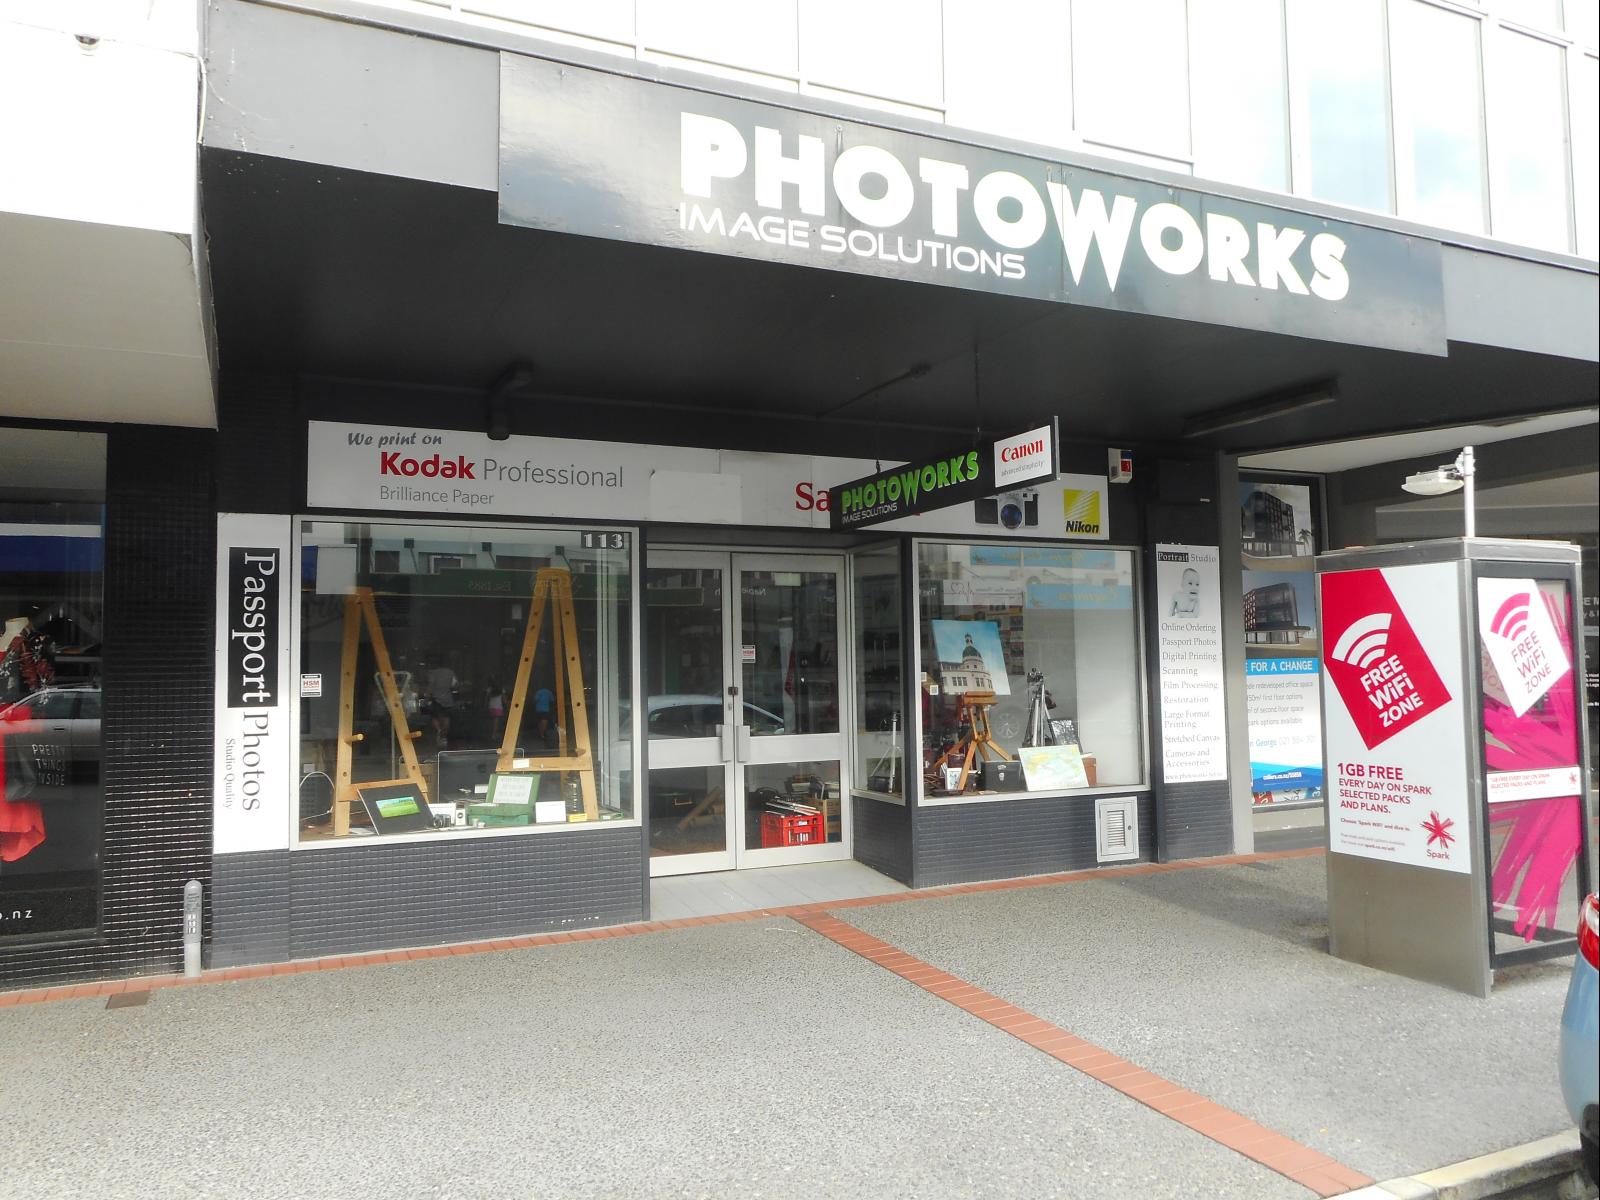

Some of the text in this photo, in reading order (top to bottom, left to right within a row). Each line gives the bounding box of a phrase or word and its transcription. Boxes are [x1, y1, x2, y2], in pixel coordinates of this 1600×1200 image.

[679, 111, 1351, 302] PHOTOWORKS
[679, 201, 1026, 280] IMAGE SOLUTIONS
[347, 432, 442, 448] We print on
[1001, 439, 1043, 463] Canon
[380, 451, 624, 488] Kodak Professional
[841, 451, 979, 514] PHOTOWORKS
[380, 485, 494, 505] Brilliance Paper
[842, 502, 898, 525] IMAGE SOLUTIONS
[1065, 519, 1100, 534] Nikon
[583, 532, 625, 550] 113
[1158, 552, 1217, 562] Portrait Studio
[231, 552, 276, 703] Passport
[1161, 622, 1217, 633] Online Ordering
[1162, 637, 1217, 648] Passport Photos
[1511, 630, 1540, 663] FREE
[1162, 651, 1217, 663] Digital Printing
[1517, 646, 1546, 679] WiFi
[1162, 666, 1198, 677] Scanning
[1251, 661, 1268, 672] FOR
[1270, 662, 1277, 671] A
[1280, 660, 1313, 671] CHANGE
[1360, 654, 1404, 692] FREE
[1163, 681, 1219, 690] Film Processing
[1525, 662, 1552, 694] ZONE
[1163, 695, 1209, 704] Restoration
[1368, 672, 1414, 710] WiFi
[1164, 710, 1210, 719] Large Format
[1379, 692, 1424, 727] ZONE
[1164, 721, 1197, 729] Printing
[242, 711, 270, 812] Photos
[1165, 748, 1210, 758] Cameras and
[223, 738, 236, 809] Studio Quality
[1337, 763, 1404, 781] 1GB FREE
[1338, 778, 1433, 795] EVERY DAY ON SPARK
[1339, 789, 1411, 805] SELECTED PACKS
[1340, 800, 1391, 814] AND PLANS.
[1426, 849, 1450, 860] Spark
[0, 909, 33, 920] .nz
